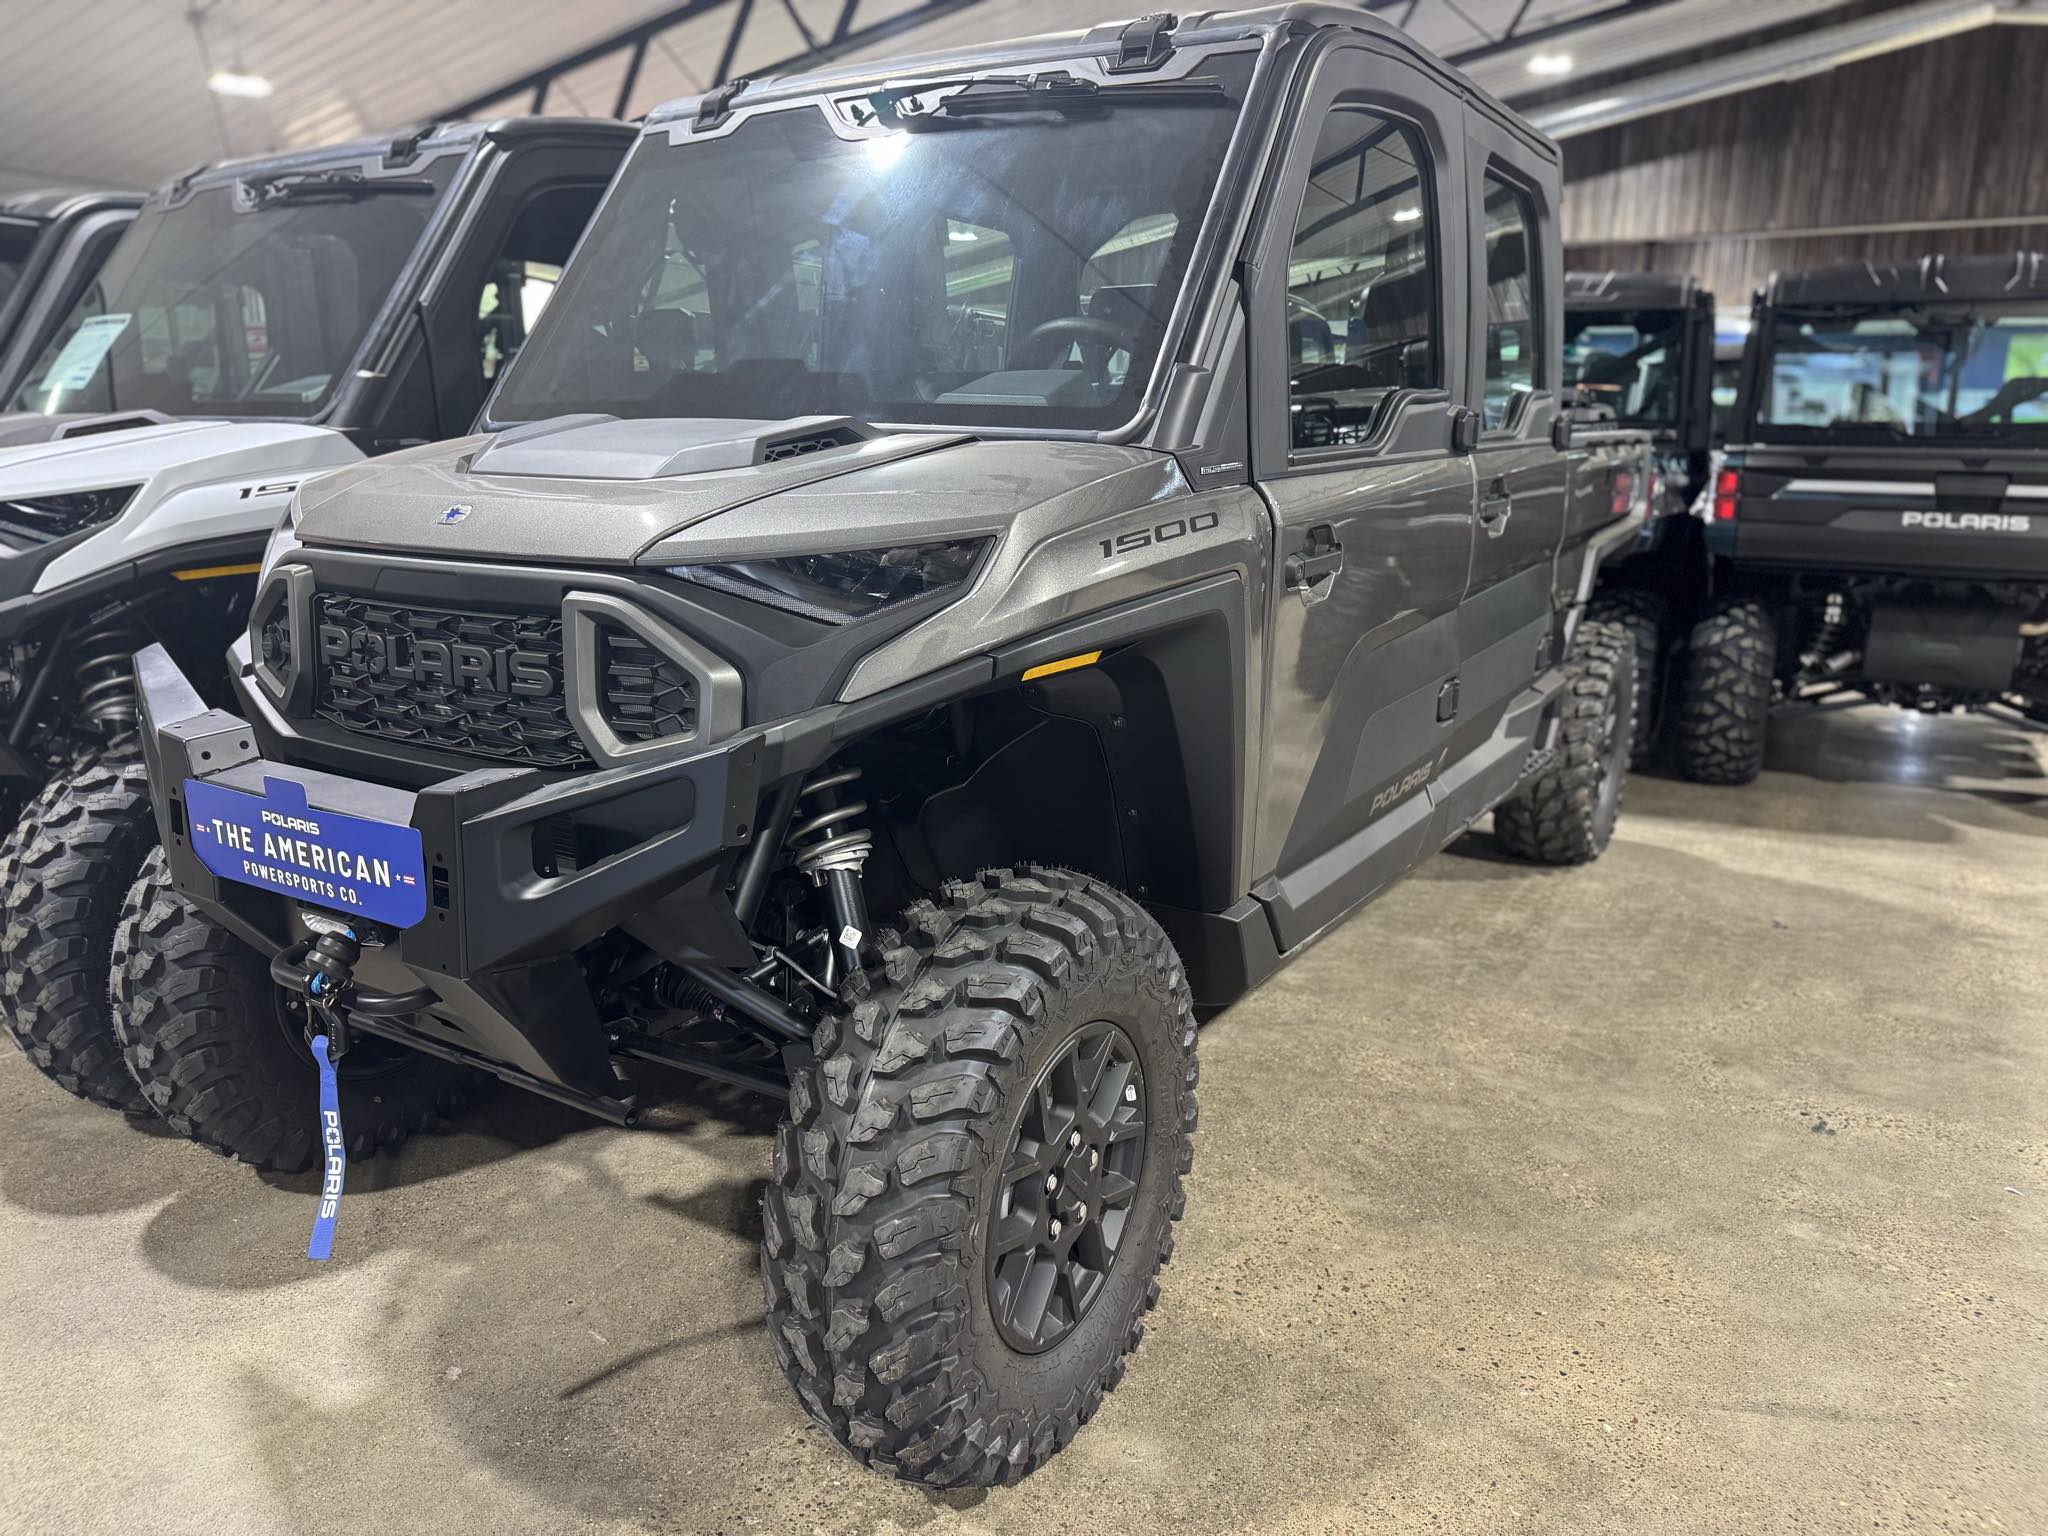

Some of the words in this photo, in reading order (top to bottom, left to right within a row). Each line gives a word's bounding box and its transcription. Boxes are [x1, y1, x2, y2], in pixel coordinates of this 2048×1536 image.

[240, 481, 299, 499] 15
[1099, 512, 1219, 559] 1500
[1902, 511, 2030, 531] POLARIS
[320, 623, 560, 697] POLARIS
[1369, 760, 1433, 816] POLARIS
[261, 810, 320, 835] POLARIS
[212, 818, 254, 853] THE
[264, 832, 391, 888] AMERICAN
[243, 860, 335, 898] POWERSPORTS
[339, 886, 363, 905] CO.
[320, 1110, 342, 1219] POLARIS
